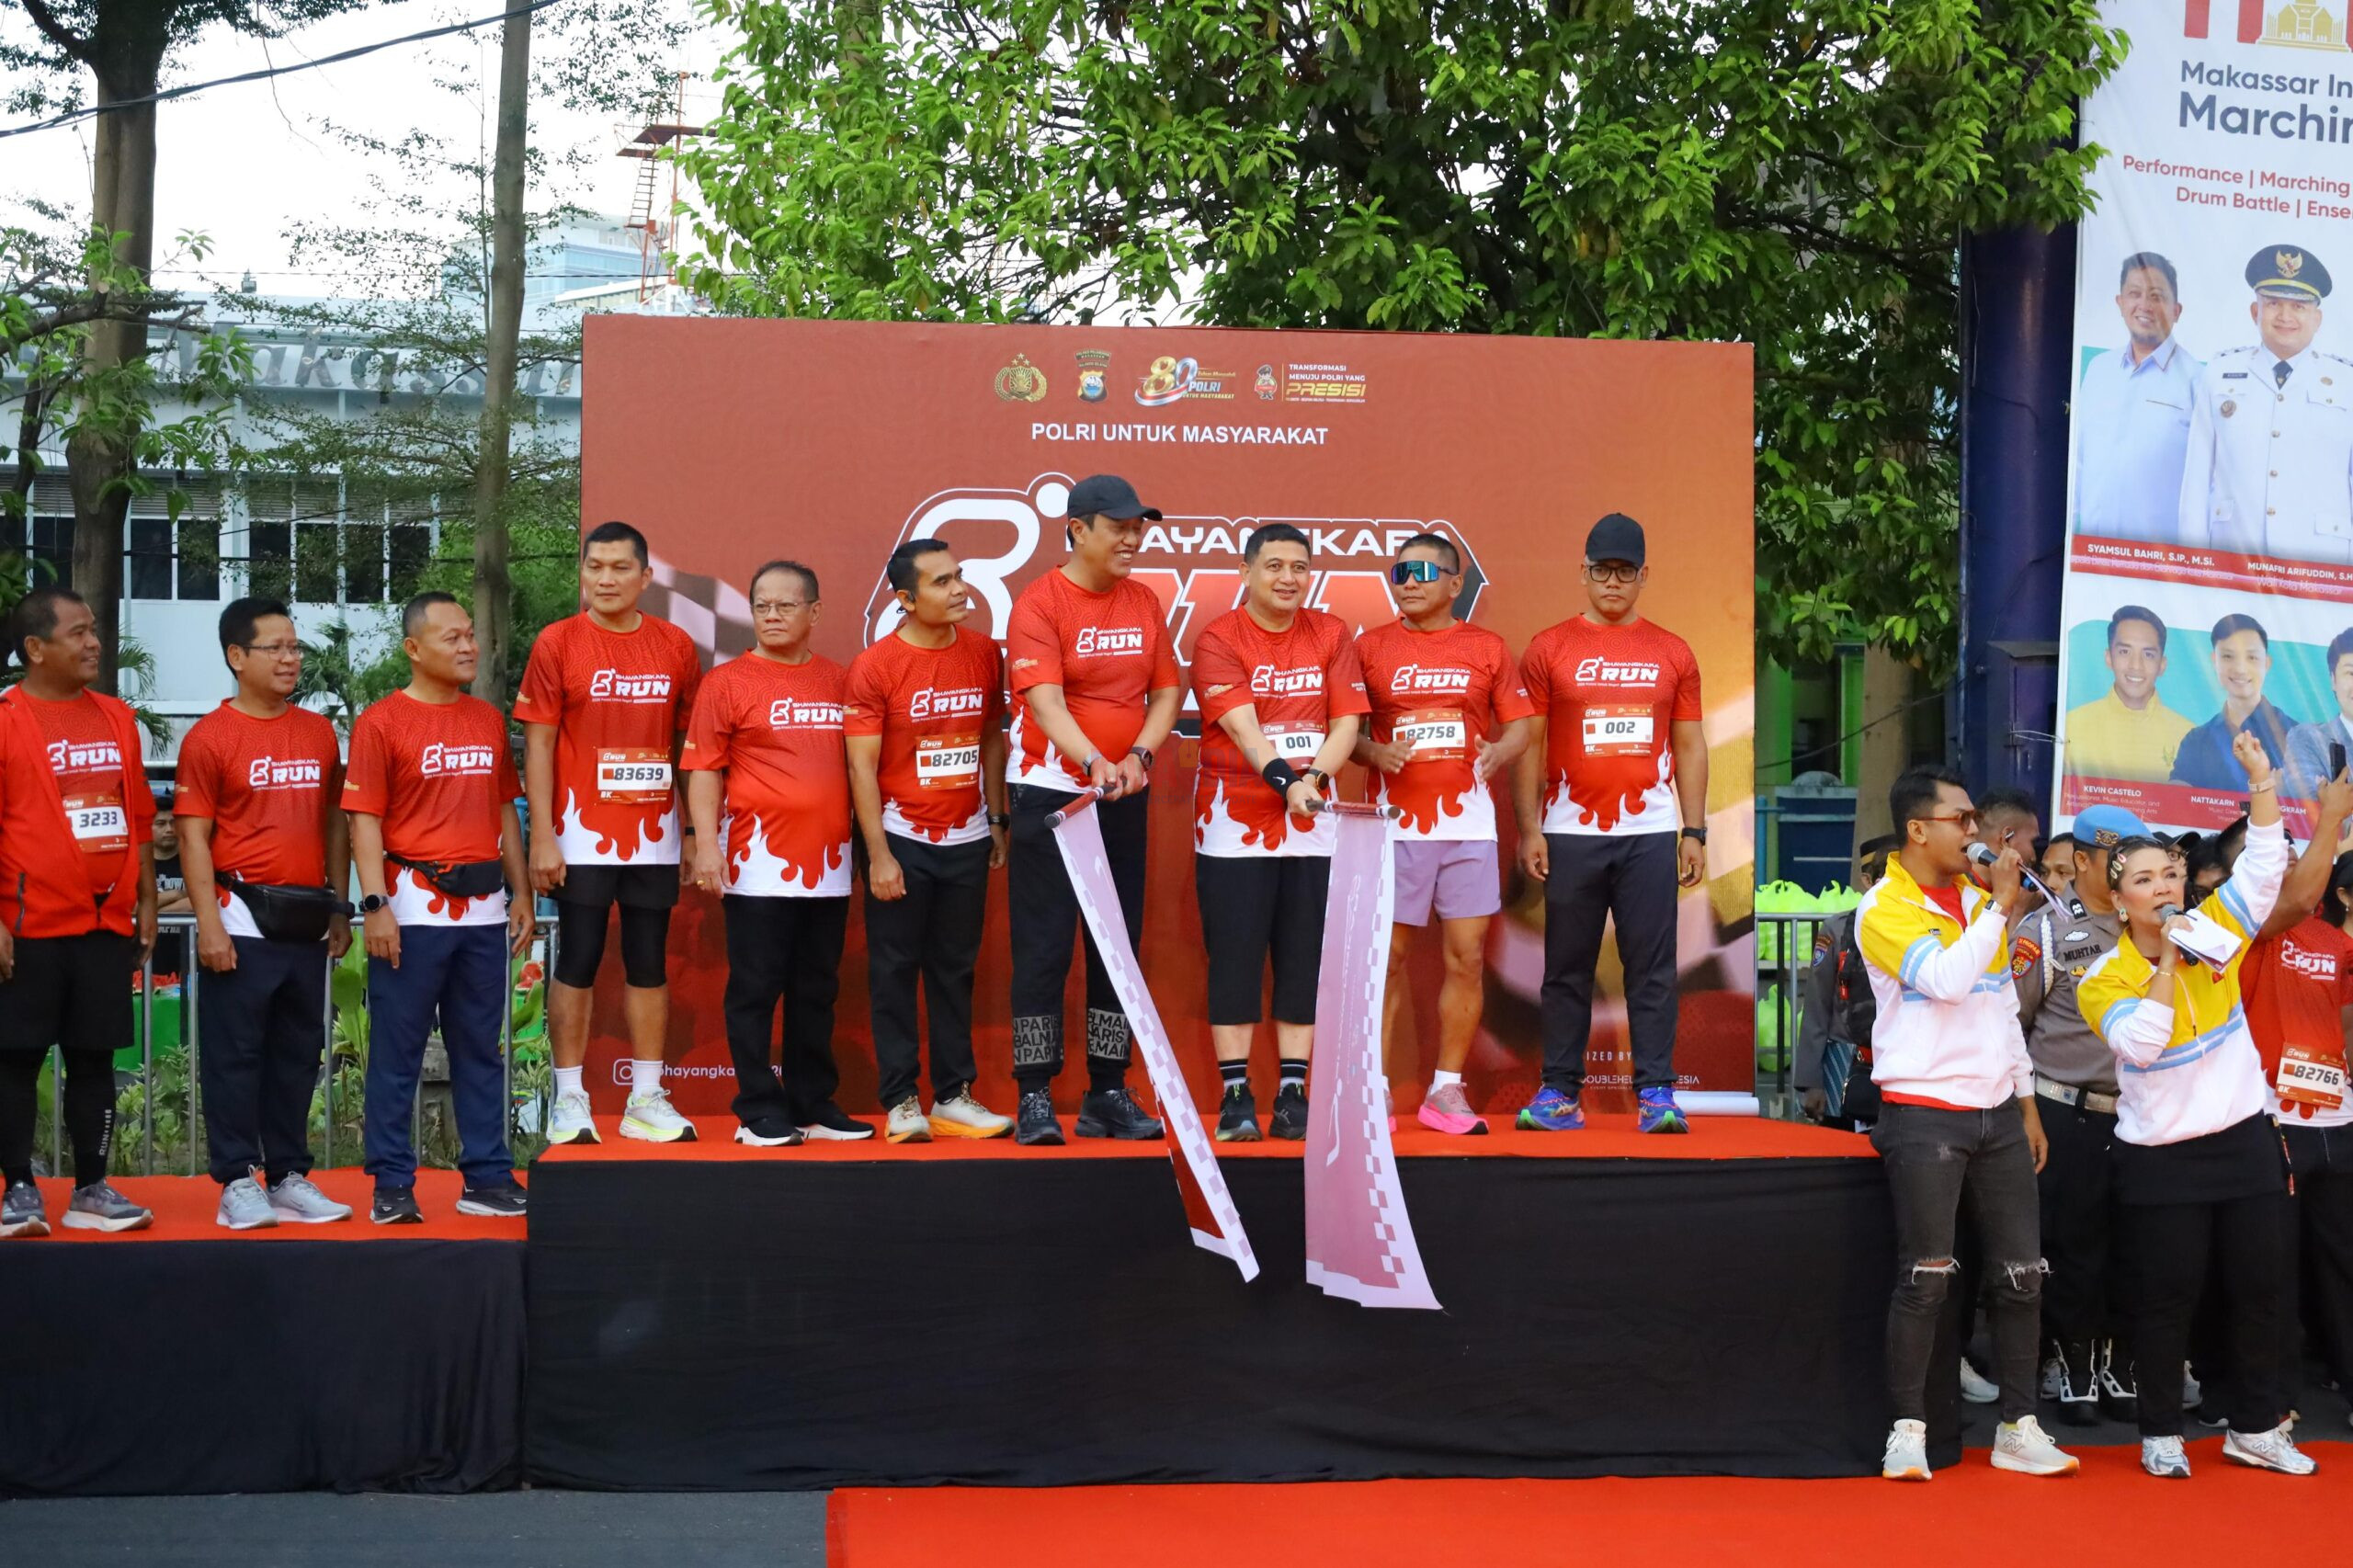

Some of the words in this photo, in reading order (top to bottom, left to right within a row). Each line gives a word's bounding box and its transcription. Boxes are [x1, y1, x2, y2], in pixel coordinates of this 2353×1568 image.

[2180, 60, 2319, 96] Makassar
[2123, 154, 2244, 184] Performance
[2260, 171, 2350, 198] Marching
[2177, 187, 2227, 207] Drum
[2233, 193, 2290, 213] Battle
[2307, 200, 2353, 220] Ense
[1289, 363, 1347, 371] TRANSFORMASI
[1188, 381, 1222, 392] POLRI
[1286, 382, 1367, 397] PRESISI
[1031, 423, 1097, 441] POLRI
[1103, 424, 1176, 442] UNTUK
[1183, 426, 1329, 445] MASYARAKAT
[2087, 543, 2132, 557] SYAMSUL
[2134, 549, 2165, 562] BAHRI,
[2247, 562, 2285, 574] MUNAFRI
[2287, 567, 2337, 581] ARIFUDDIN,
[1097, 634, 1142, 650] RUN
[1415, 674, 1470, 688] RUN
[1601, 667, 1659, 681] RUN
[615, 681, 671, 696] RUN
[933, 694, 983, 713] RUN
[793, 709, 844, 723] RUN
[1406, 726, 1456, 741] 82758
[1605, 722, 1635, 734] 002
[1286, 735, 1311, 749] 001
[70, 747, 121, 767] RUN
[445, 752, 493, 769] RUN
[932, 749, 977, 767] 82705
[272, 766, 321, 783] RUN
[614, 767, 664, 780] 83639
[2084, 785, 2106, 794] KEVIN
[2107, 788, 2142, 797] CASTELO
[2190, 796, 2234, 807] NATTAKARN
[2063, 944, 2102, 962] MUHTAR
[2294, 954, 2336, 973] RUN
[1619, 1051, 1632, 1062] BY
[2294, 1065, 2340, 1085] 82766
